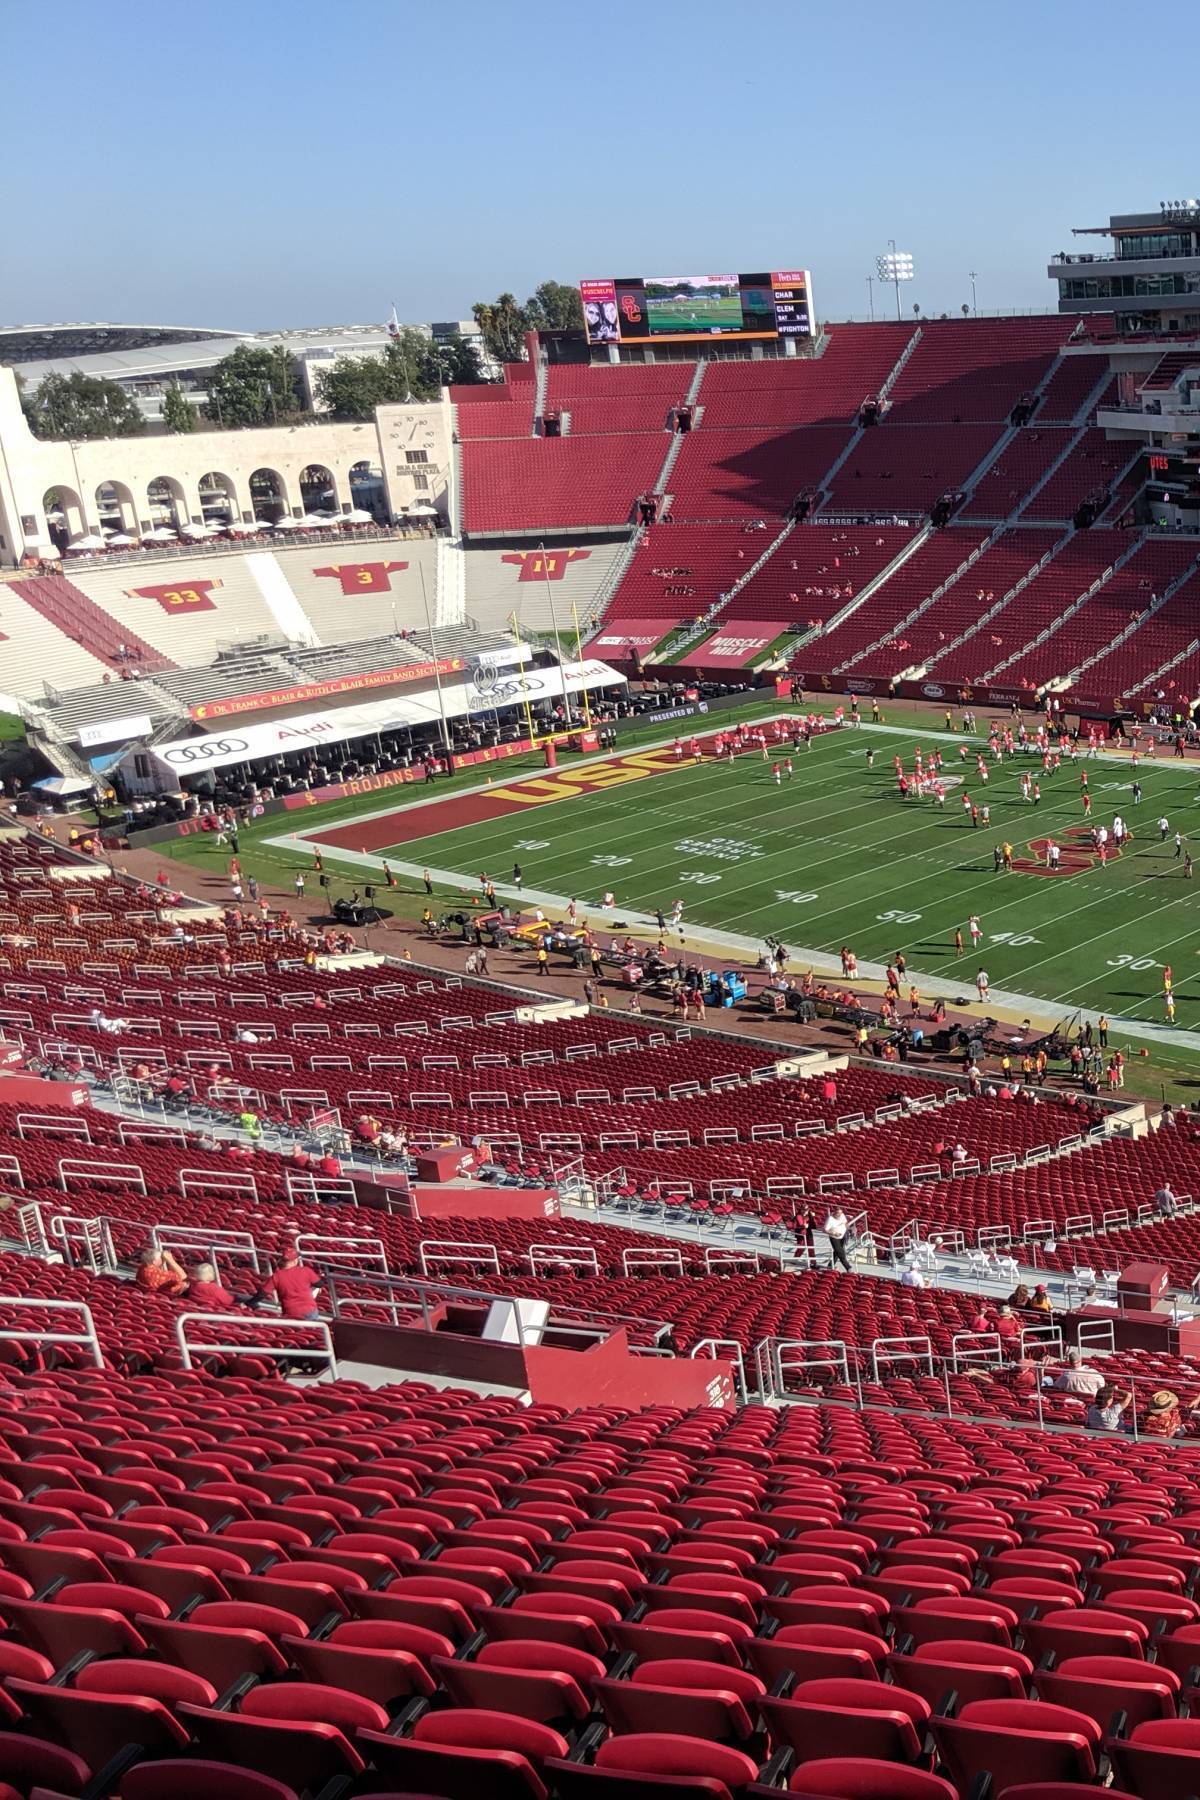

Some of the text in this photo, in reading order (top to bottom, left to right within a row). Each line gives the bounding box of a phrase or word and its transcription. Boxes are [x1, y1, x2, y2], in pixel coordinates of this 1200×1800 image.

[1150, 456, 1168, 469] UTES
[532, 558, 556, 573] 11
[357, 571, 373, 585] 3
[164, 589, 200, 606] 33
[709, 637, 769, 648] MUSCLE
[708, 647, 750, 656] MILK
[340, 680, 363, 690] BLAIR
[364, 675, 392, 686] FAMILY
[393, 670, 415, 681] BAND
[416, 664, 448, 676] SECTION
[564, 665, 609, 680] Audi
[650, 706, 695, 722] PRESENTED BY
[277, 721, 334, 740] Audi
[340, 768, 414, 797] TROJANS
[479, 749, 718, 803] USC
[775, 889, 819, 903] 40
[875, 910, 922, 924] 50
[989, 932, 1036, 947] 40
[1106, 954, 1157, 971] 30
